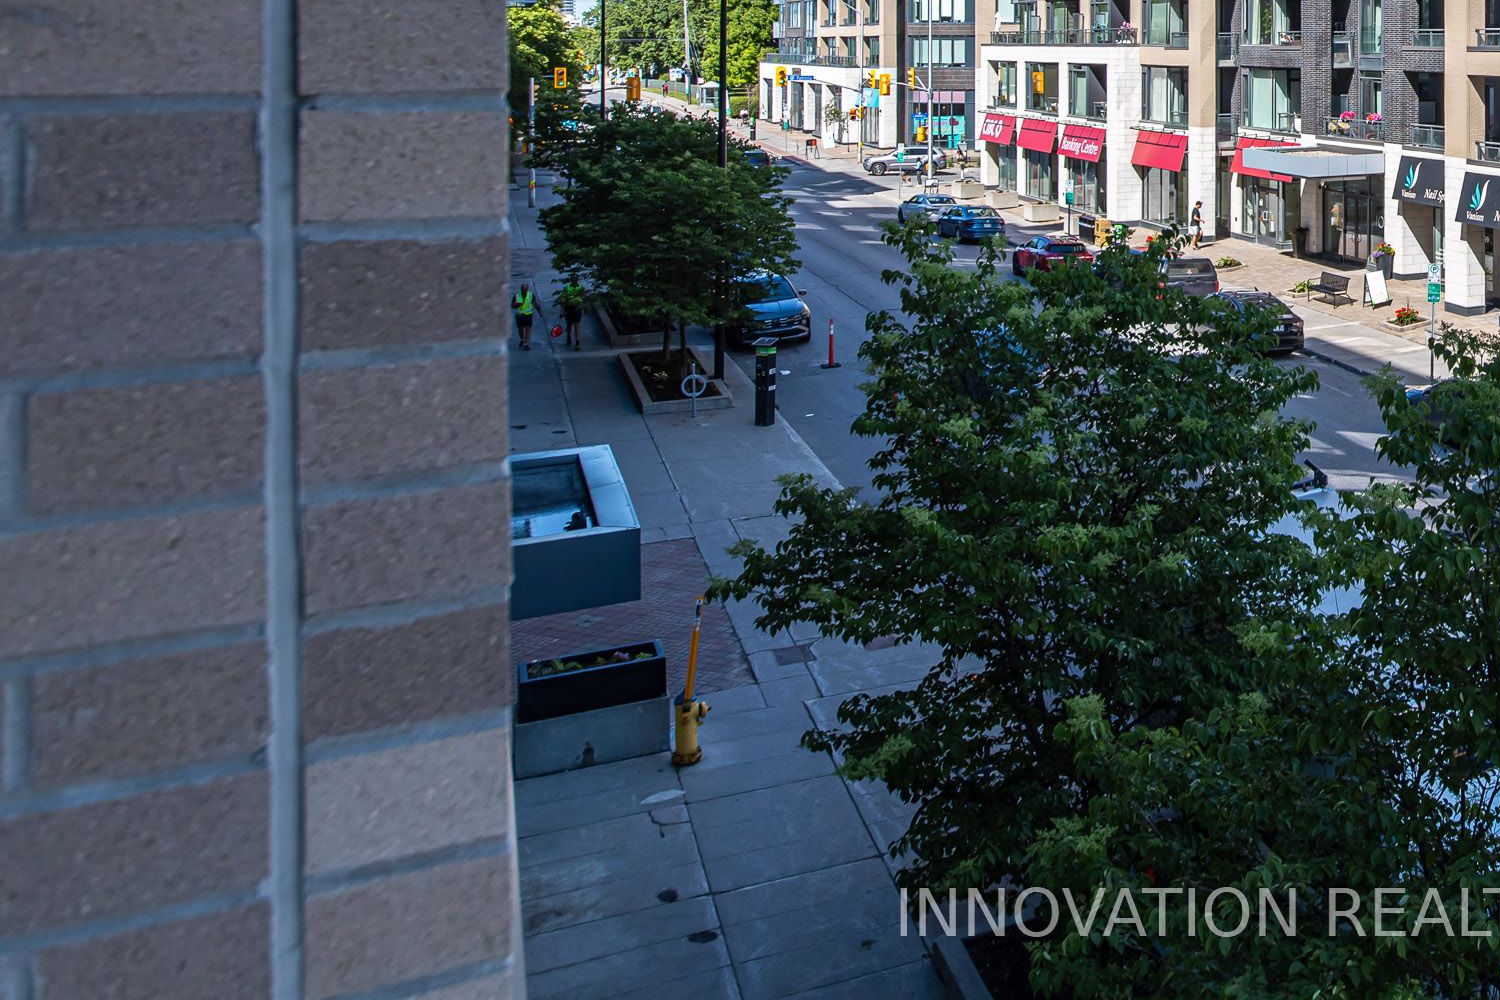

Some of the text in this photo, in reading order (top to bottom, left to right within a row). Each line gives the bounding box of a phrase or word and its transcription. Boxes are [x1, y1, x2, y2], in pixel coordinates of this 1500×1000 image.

[1061, 137, 1098, 155] Banking Centre
[1424, 188, 1445, 203] Nail Sp
